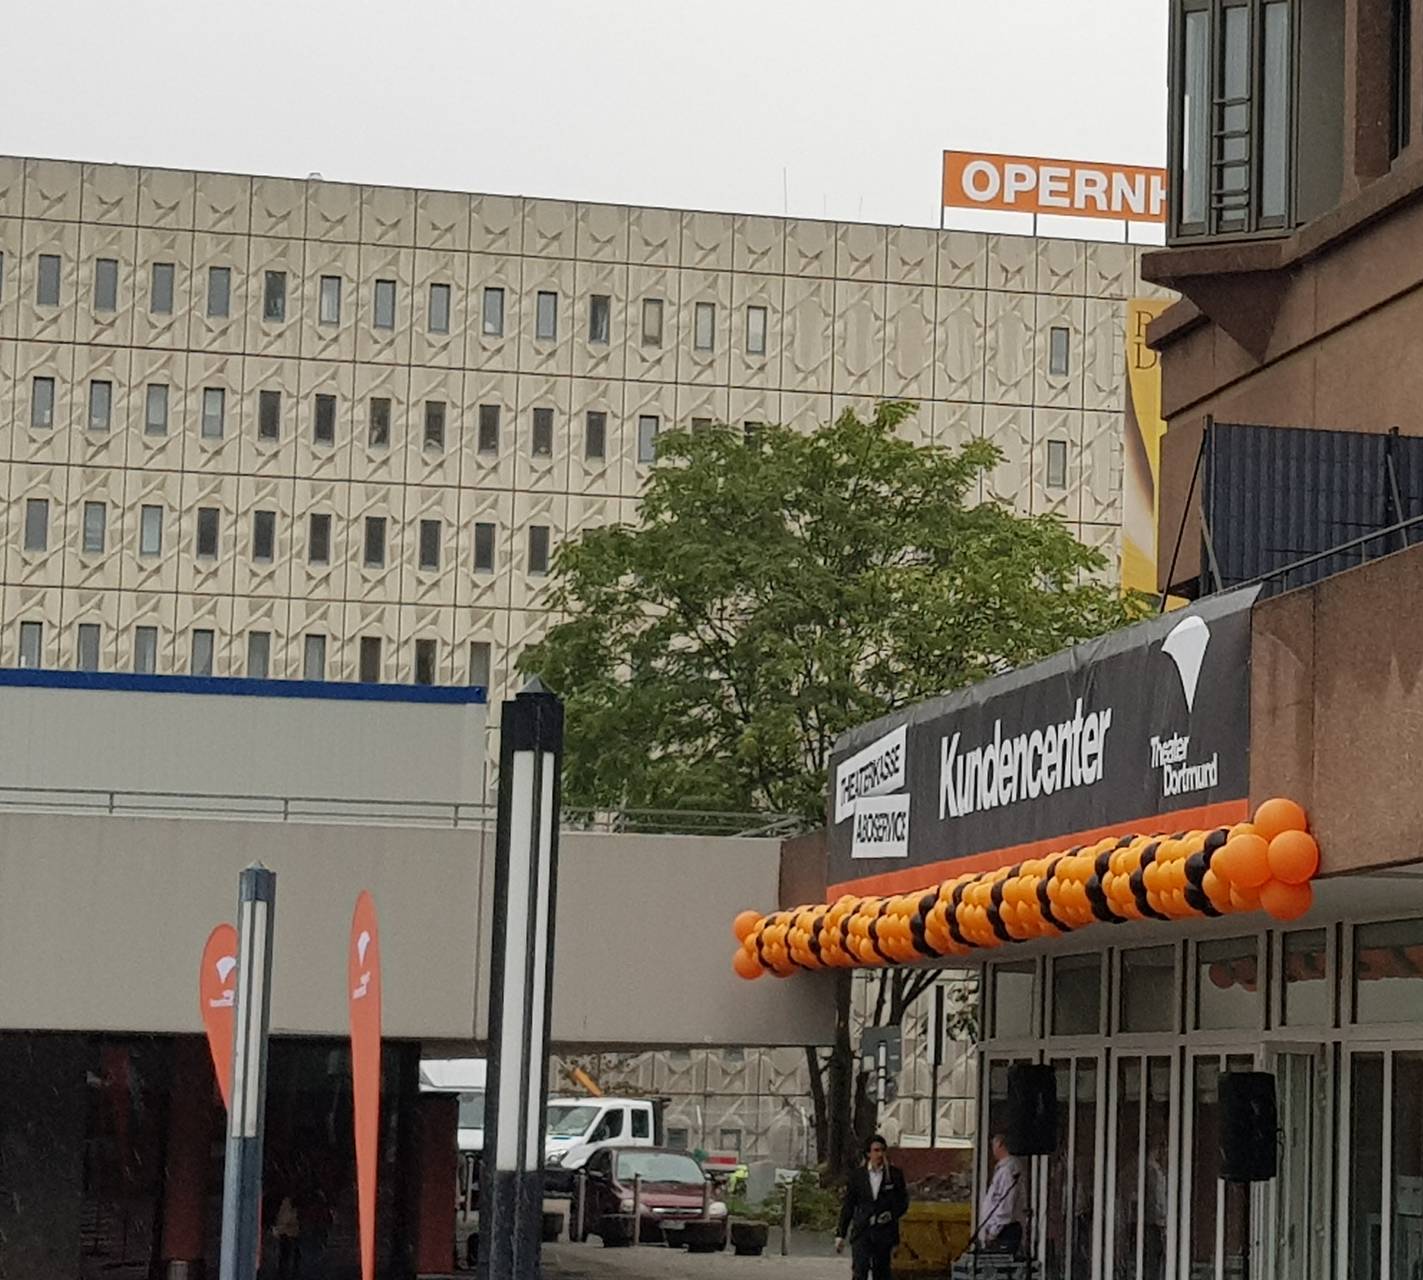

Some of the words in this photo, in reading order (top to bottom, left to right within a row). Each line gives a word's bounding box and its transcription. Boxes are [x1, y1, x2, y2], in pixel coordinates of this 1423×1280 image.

[939, 697, 1112, 820] Kundencenter
[1151, 732, 1190, 768] Theater
[841, 743, 901, 807] THEATERKASSE
[1163, 752, 1218, 797] Dortmund
[856, 811, 907, 842] ABOSERVICE
